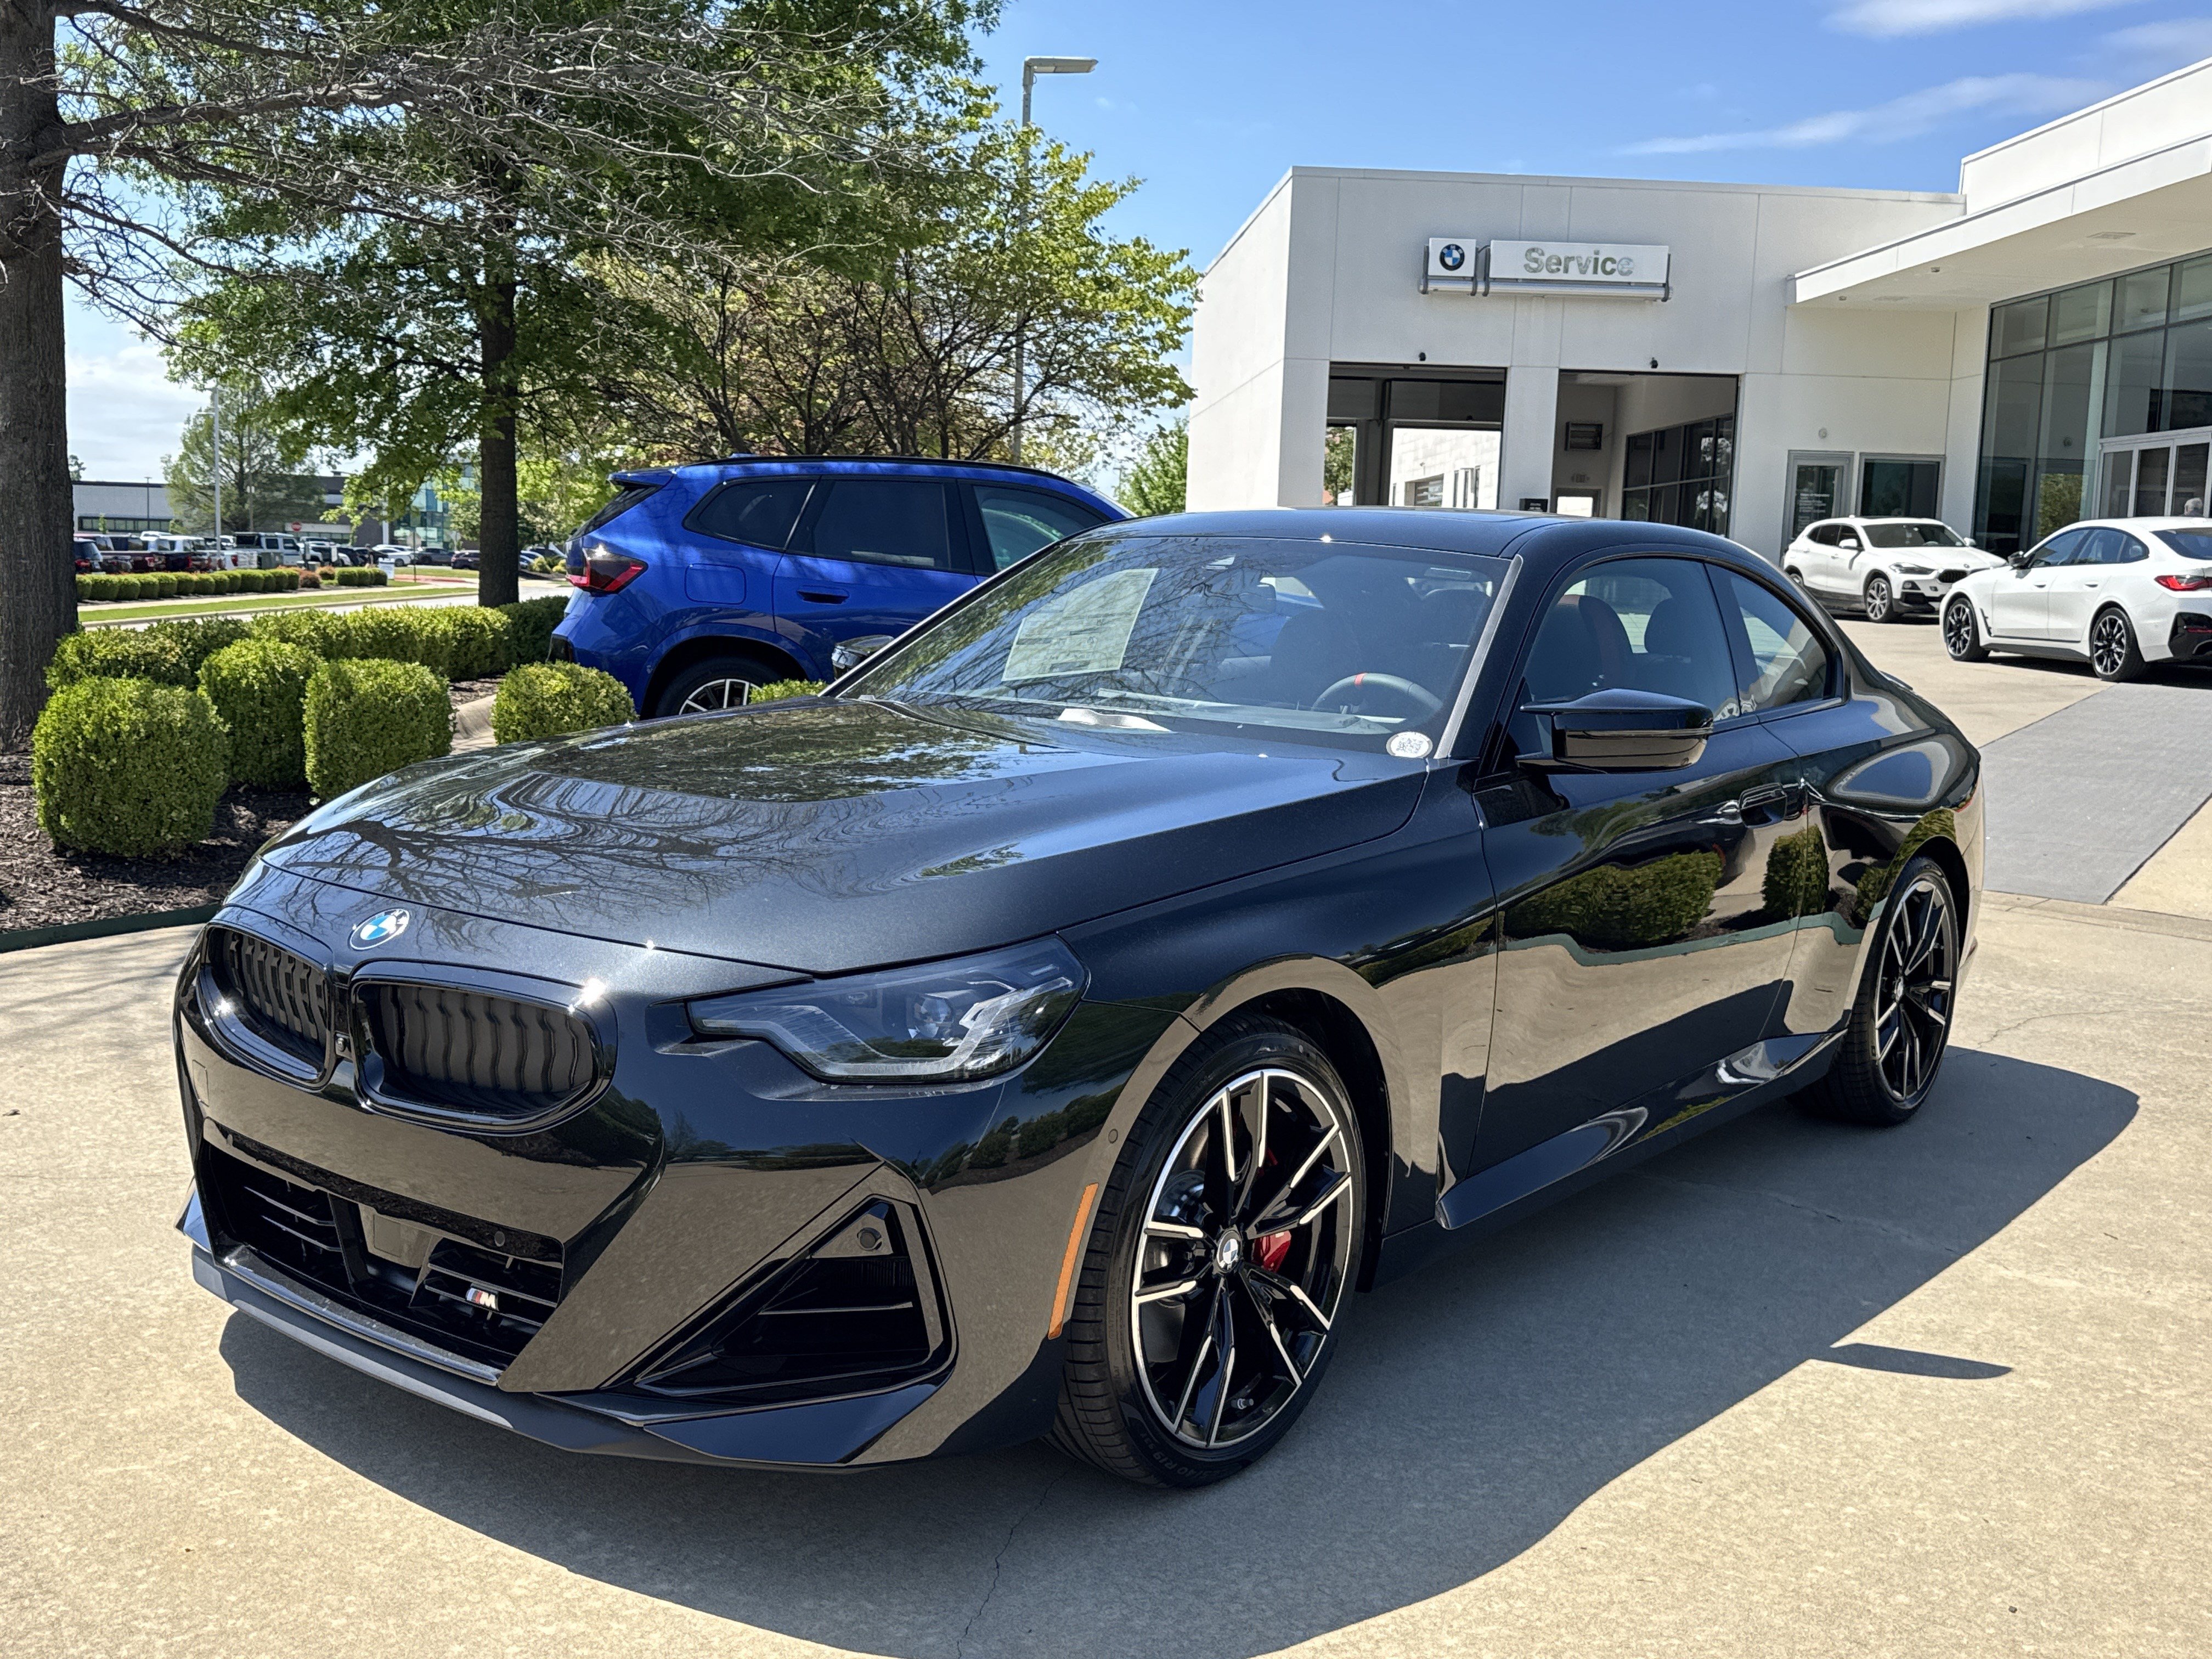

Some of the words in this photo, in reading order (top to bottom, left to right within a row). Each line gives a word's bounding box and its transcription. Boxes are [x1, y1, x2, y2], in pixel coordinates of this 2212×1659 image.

[1523, 247, 1634, 276] Service
[479, 1291, 496, 1309] M
[1153, 1451, 1177, 1469] R19
